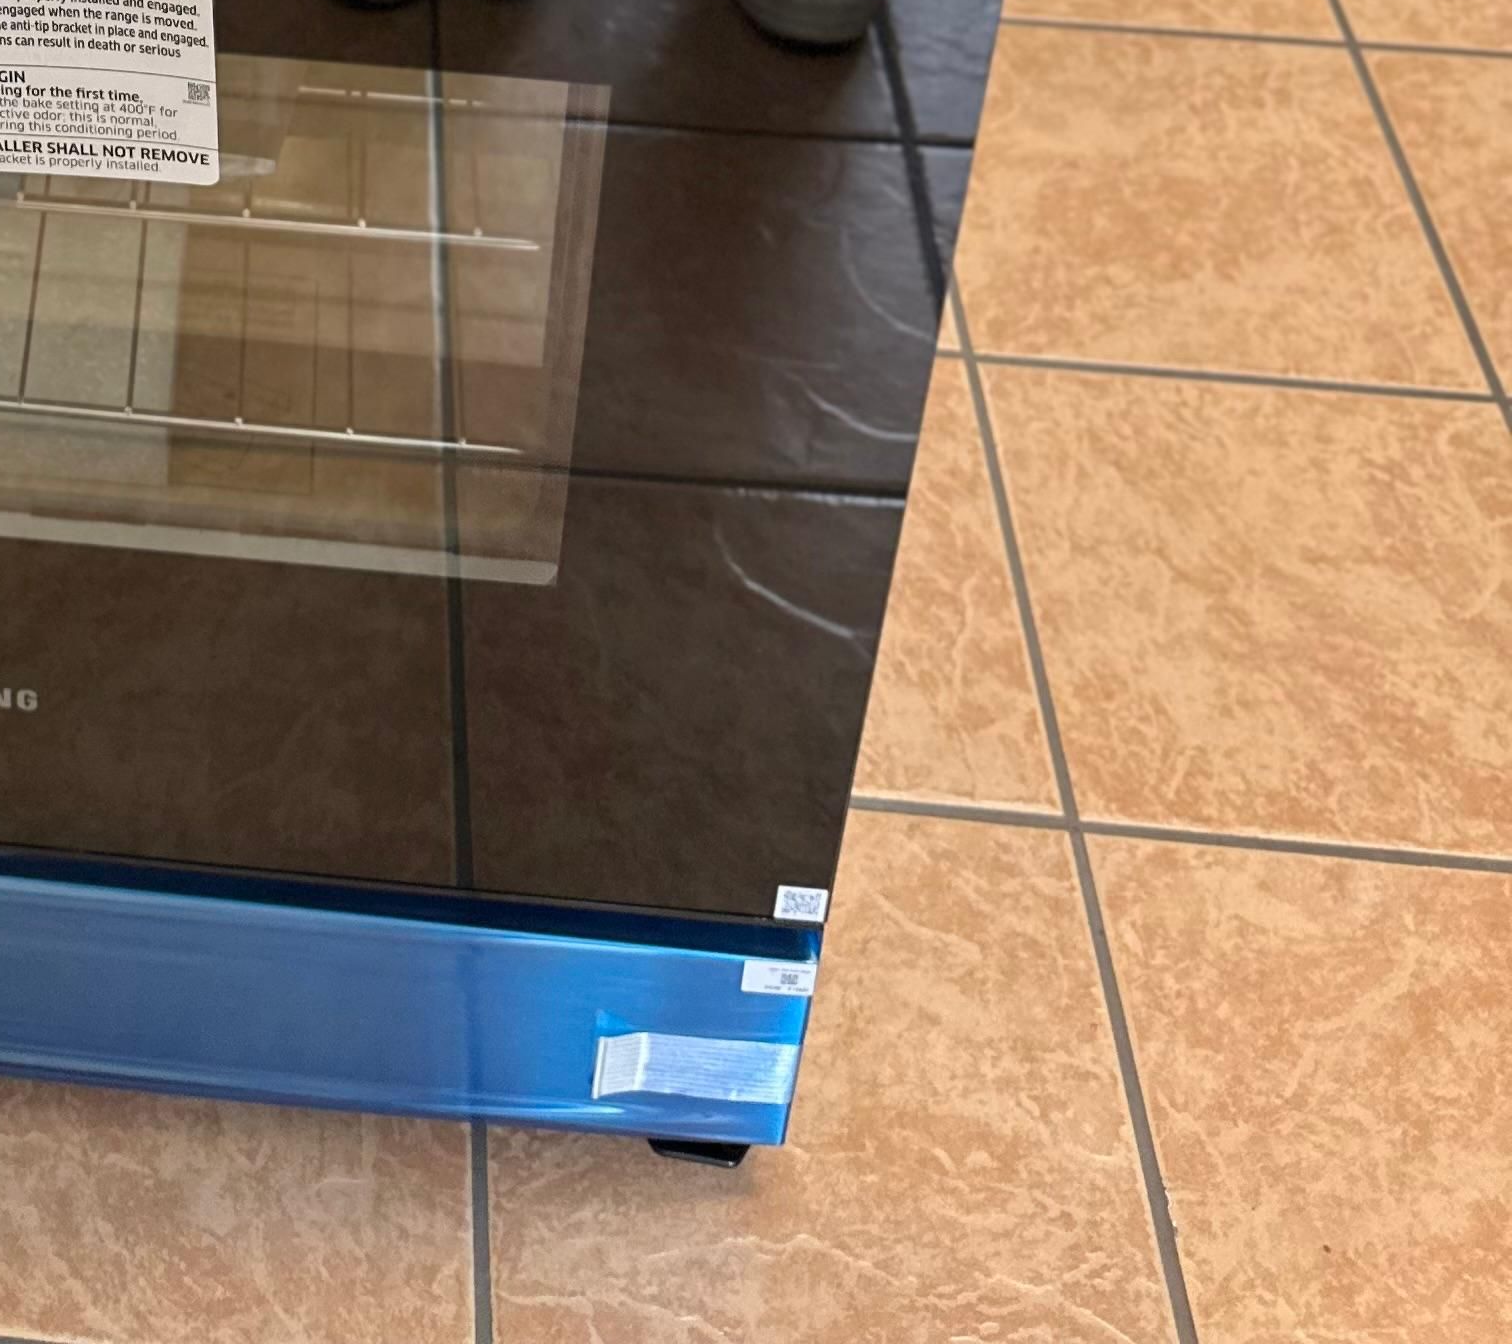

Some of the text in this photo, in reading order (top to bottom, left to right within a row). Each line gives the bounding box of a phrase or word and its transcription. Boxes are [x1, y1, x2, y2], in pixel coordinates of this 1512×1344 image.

[146, 1, 200, 17] engaged.
[47, 142, 98, 157] SHALL
[102, 145, 135, 159] NOT
[140, 148, 210, 165] REMOVE
